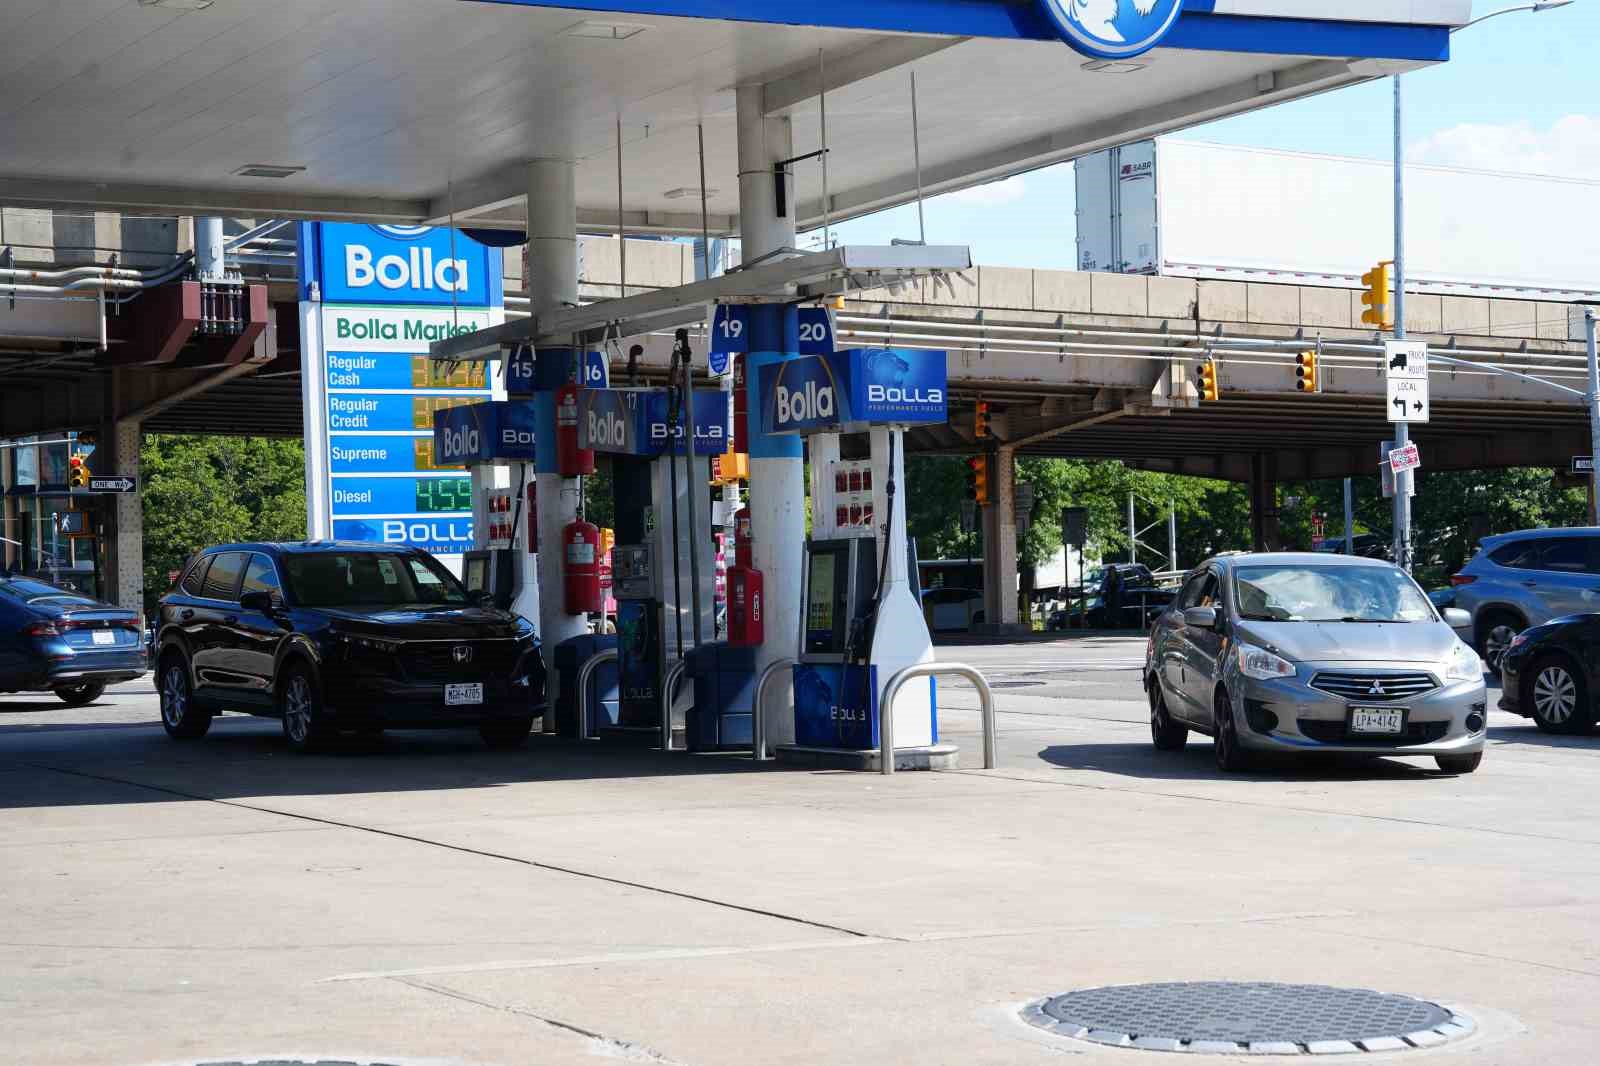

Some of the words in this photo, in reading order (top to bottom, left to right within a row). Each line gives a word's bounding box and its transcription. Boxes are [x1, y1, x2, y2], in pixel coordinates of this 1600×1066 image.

[345, 244, 469, 292] Bolla
[336, 318, 397, 340] Bolla
[719, 319, 743, 338] 19
[799, 323, 826, 342] 20
[329, 356, 377, 373] Regular
[511, 362, 533, 378] 15
[584, 364, 602, 381] 16
[329, 372, 360, 386] Cash
[1397, 383, 1417, 392] LOCAL
[330, 398, 379, 415] Regular
[776, 382, 834, 424] Bolla
[331, 414, 369, 428] Credit
[588, 410, 625, 447] Bolla
[444, 425, 479, 457] Bolla
[332, 447, 387, 462] Supreme
[95, 480, 109, 488] ONE
[115, 480, 128, 489] WAY
[334, 490, 372, 503] Diesel
